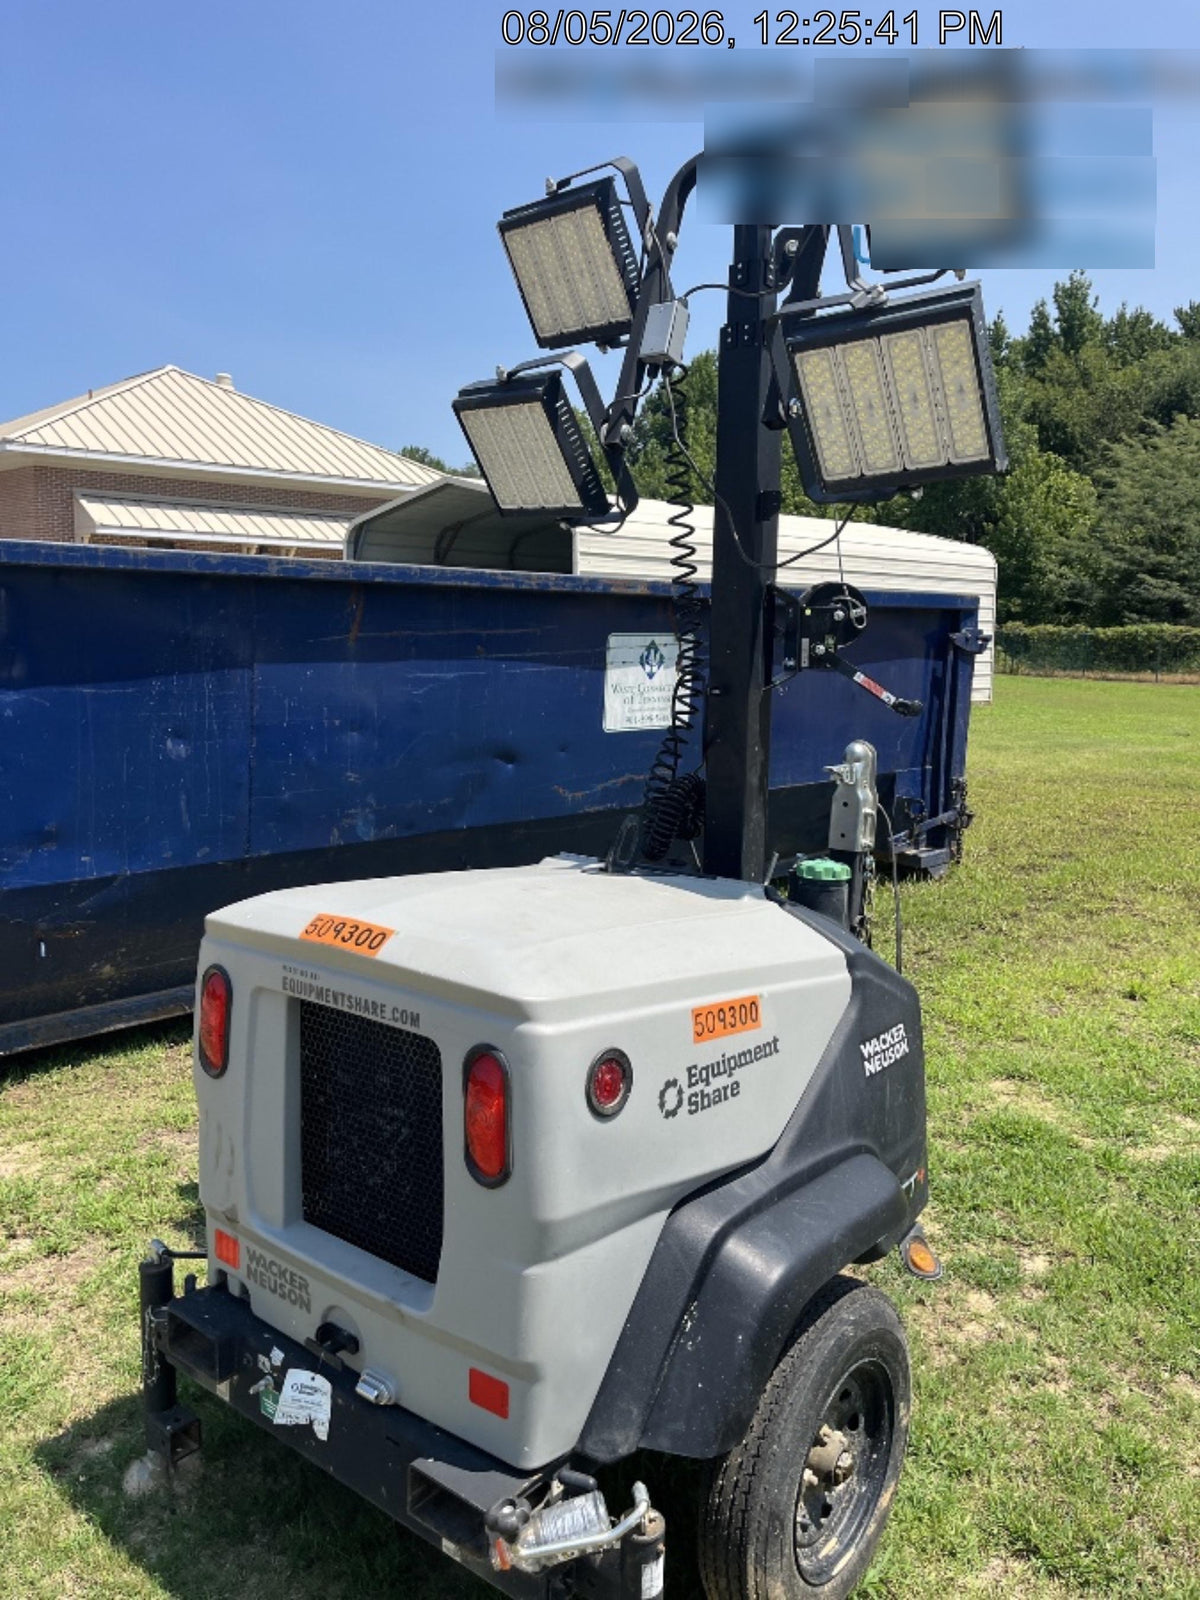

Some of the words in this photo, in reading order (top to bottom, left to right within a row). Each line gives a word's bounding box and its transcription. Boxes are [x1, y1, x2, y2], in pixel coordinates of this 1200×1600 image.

[304, 917, 388, 951] 509300
[281, 975, 421, 1029] EQUIPMENTSHARE.COM
[694, 1000, 759, 1037] 509300
[860, 1023, 906, 1059] WACKER
[863, 1038, 909, 1077] NEUSON
[686, 1035, 779, 1088] Equipment
[687, 1080, 741, 1116] Share
[246, 1246, 310, 1296] WACKER
[246, 1263, 312, 1315] NEUSON
